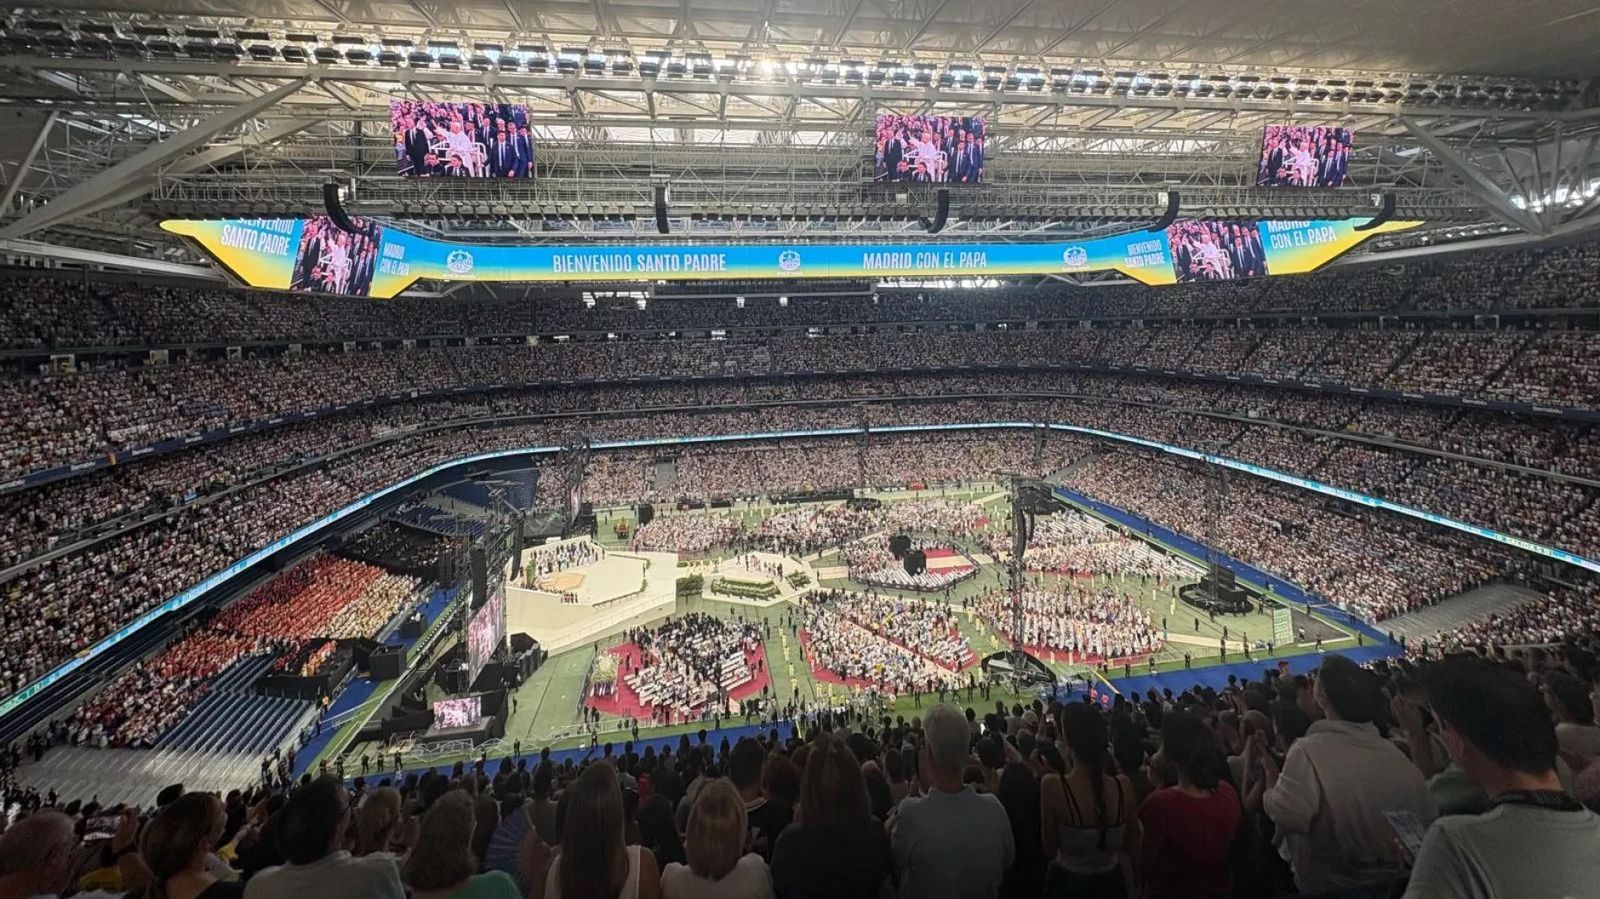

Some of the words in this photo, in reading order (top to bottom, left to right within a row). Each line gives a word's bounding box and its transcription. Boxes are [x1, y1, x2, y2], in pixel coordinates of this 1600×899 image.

[221, 224, 258, 250] SANTO
[258, 231, 291, 256] PADRE
[1270, 234, 1292, 249] CON
[1293, 230, 1307, 246] EL
[1307, 225, 1337, 245] PAPA
[553, 254, 632, 273] BIENVENIDO
[637, 254, 680, 272] SANTO
[684, 253, 726, 271] PADRE
[863, 252, 912, 269] MADRID
[916, 252, 939, 269] CON
[944, 252, 955, 268] EL
[960, 251, 987, 268] PAPA
[1143, 252, 1165, 267] PADRE
